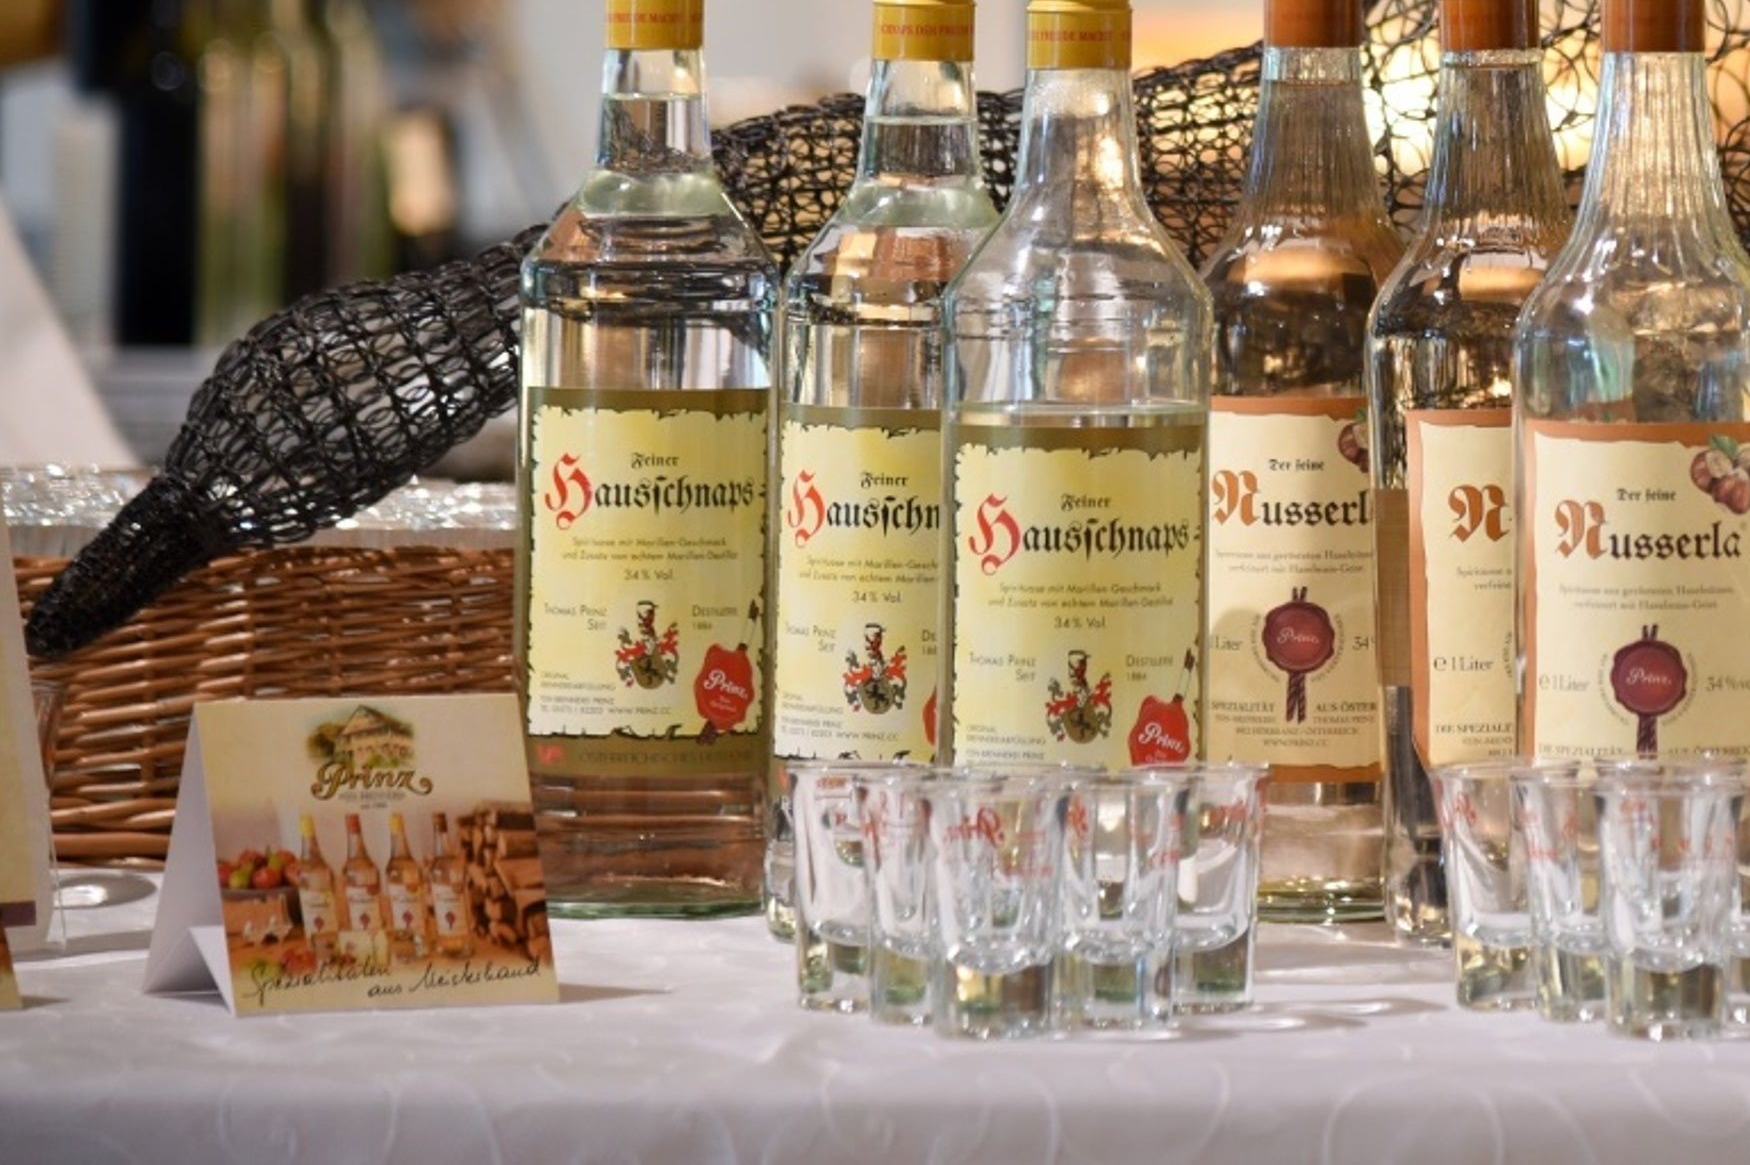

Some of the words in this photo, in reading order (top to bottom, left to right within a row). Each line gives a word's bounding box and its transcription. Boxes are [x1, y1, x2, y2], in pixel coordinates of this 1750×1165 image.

[631, 452, 680, 469] Feiner
[860, 471, 908, 489] Feiner
[1061, 494, 1111, 512] Feiner
[1554, 499, 1742, 560] Nusserla
[1459, 655, 1494, 672] Liter
[704, 669, 748, 700] Prinz
[1139, 722, 1186, 753] Prinz
[311, 761, 433, 801] Prinz
